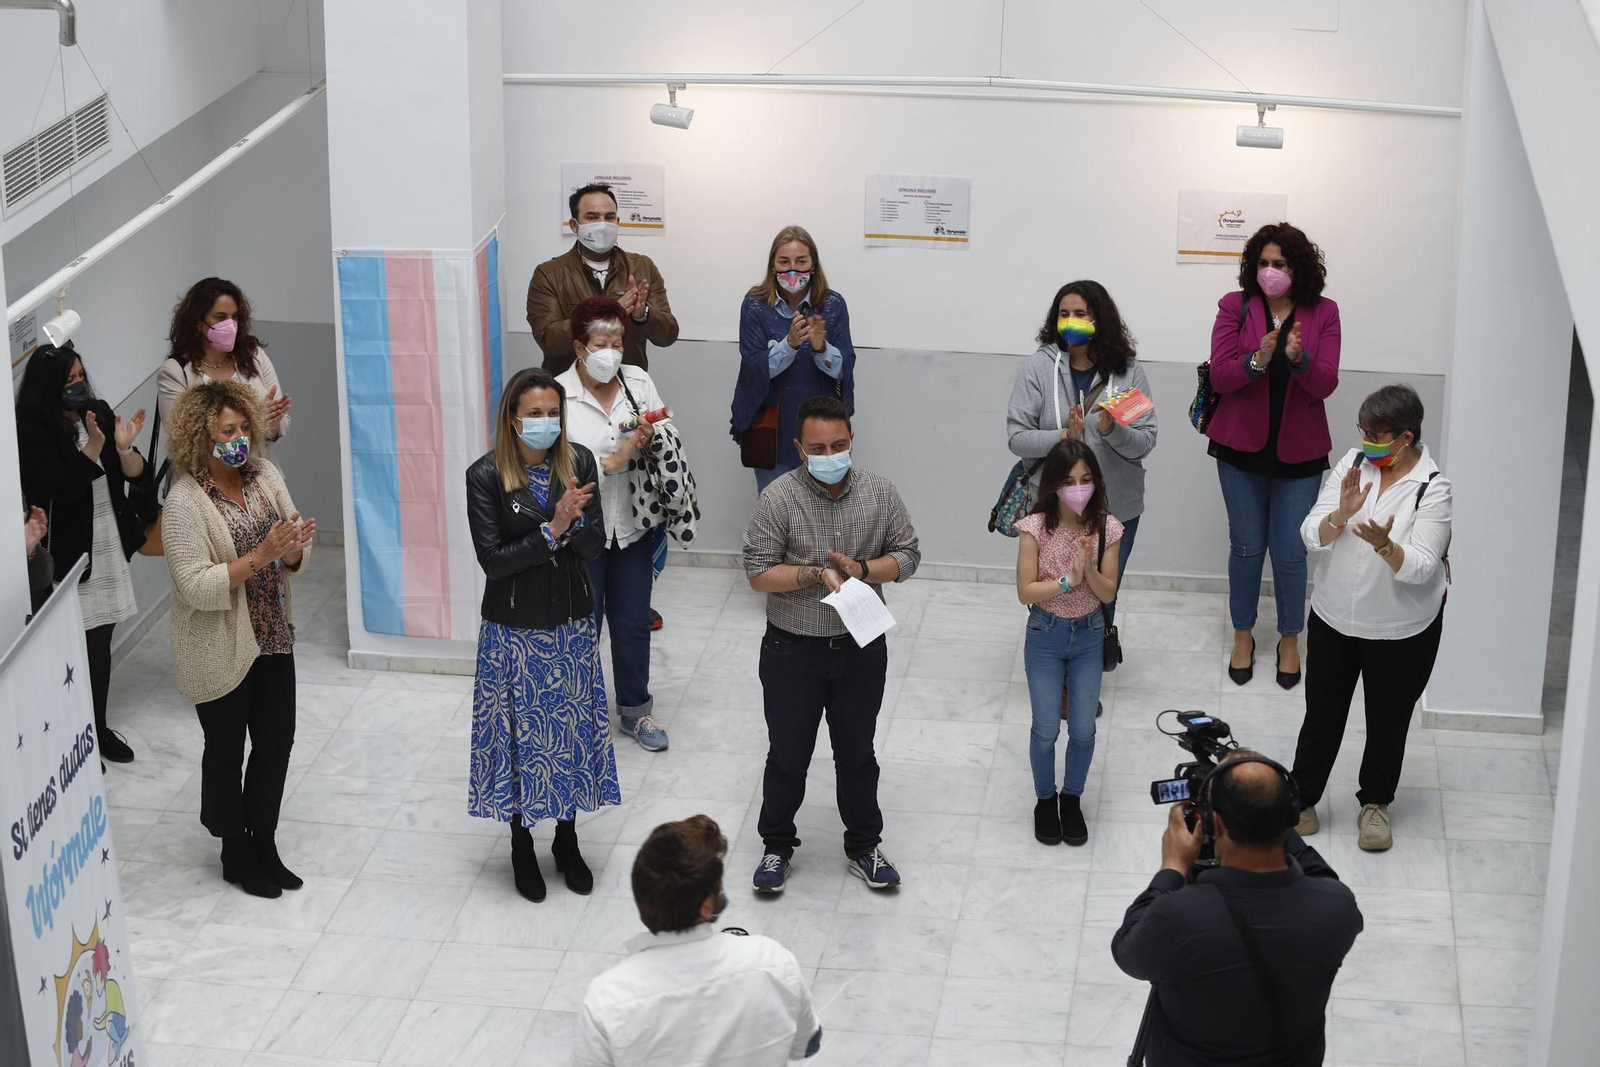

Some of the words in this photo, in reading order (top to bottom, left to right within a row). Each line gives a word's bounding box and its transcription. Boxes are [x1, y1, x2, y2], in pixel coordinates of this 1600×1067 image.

[11, 816, 28, 861] Si
[27, 775, 57, 842] tienes
[59, 722, 94, 794] dudas
[25, 795, 107, 940] Infórmate
